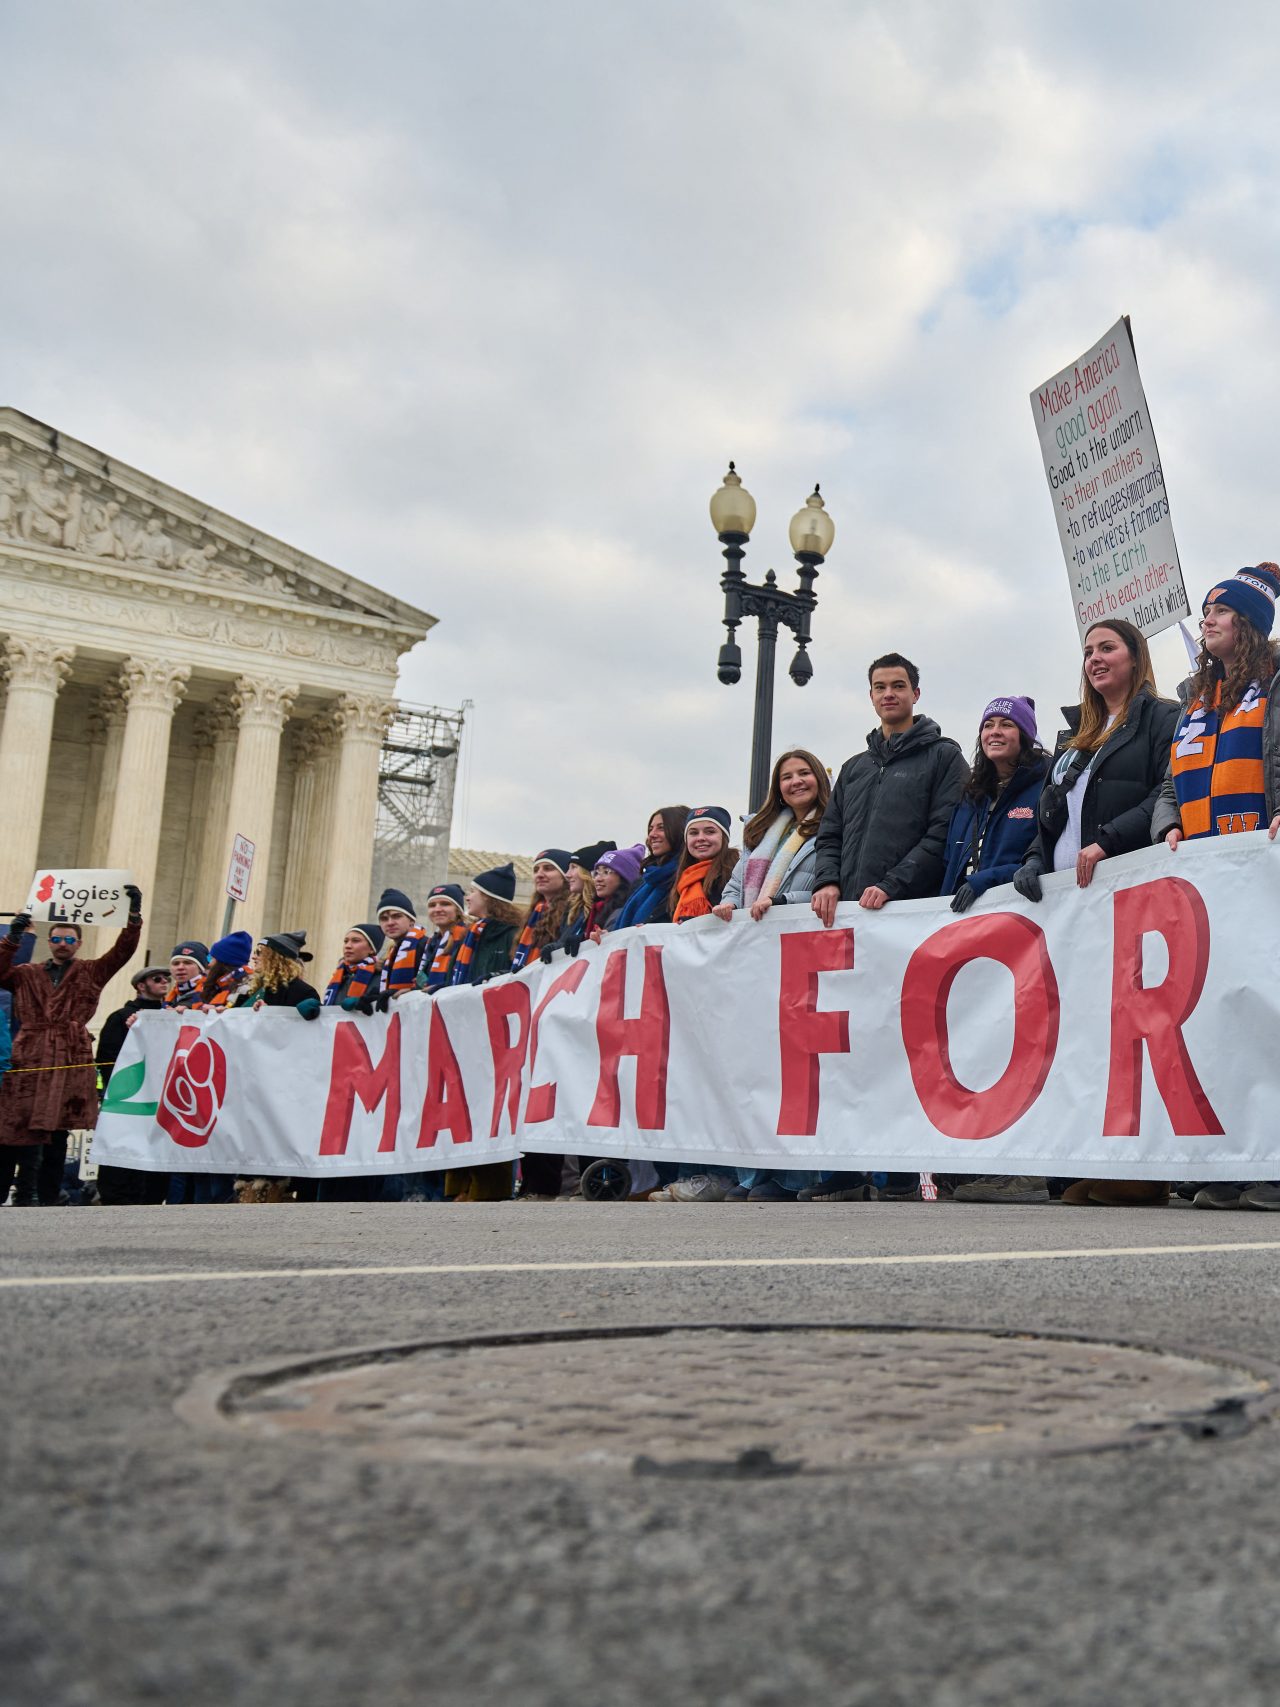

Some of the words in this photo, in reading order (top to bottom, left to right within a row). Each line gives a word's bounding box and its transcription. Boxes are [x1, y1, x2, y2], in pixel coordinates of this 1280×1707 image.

[1038, 381, 1073, 423] Make
[1074, 341, 1120, 401] America
[1055, 405, 1087, 459] good
[1087, 385, 1122, 434] again
[1048, 454, 1076, 489] Good
[1075, 449, 1088, 472] to
[1088, 436, 1108, 464] the
[1109, 409, 1143, 451] unborn
[1074, 474, 1099, 504] their
[1101, 447, 1143, 488] mothers
[1081, 487, 1128, 527] refugees
[1086, 524, 1124, 561] workers
[1130, 496, 1169, 537] farmers
[1092, 561, 1111, 588] the
[1112, 540, 1148, 578] Earth
[1077, 593, 1105, 625] Good
[1105, 589, 1118, 612] to
[1118, 574, 1144, 606] each
[1133, 597, 1161, 629] black
[1164, 583, 1187, 614] white
[233, 849, 251, 870] PARKING
[235, 866, 244, 878] ANY
[240, 841, 249, 855] NO
[48, 901, 94, 924] Life
[318, 944, 670, 1156] MARCH
[776, 876, 1226, 1140] FOR
